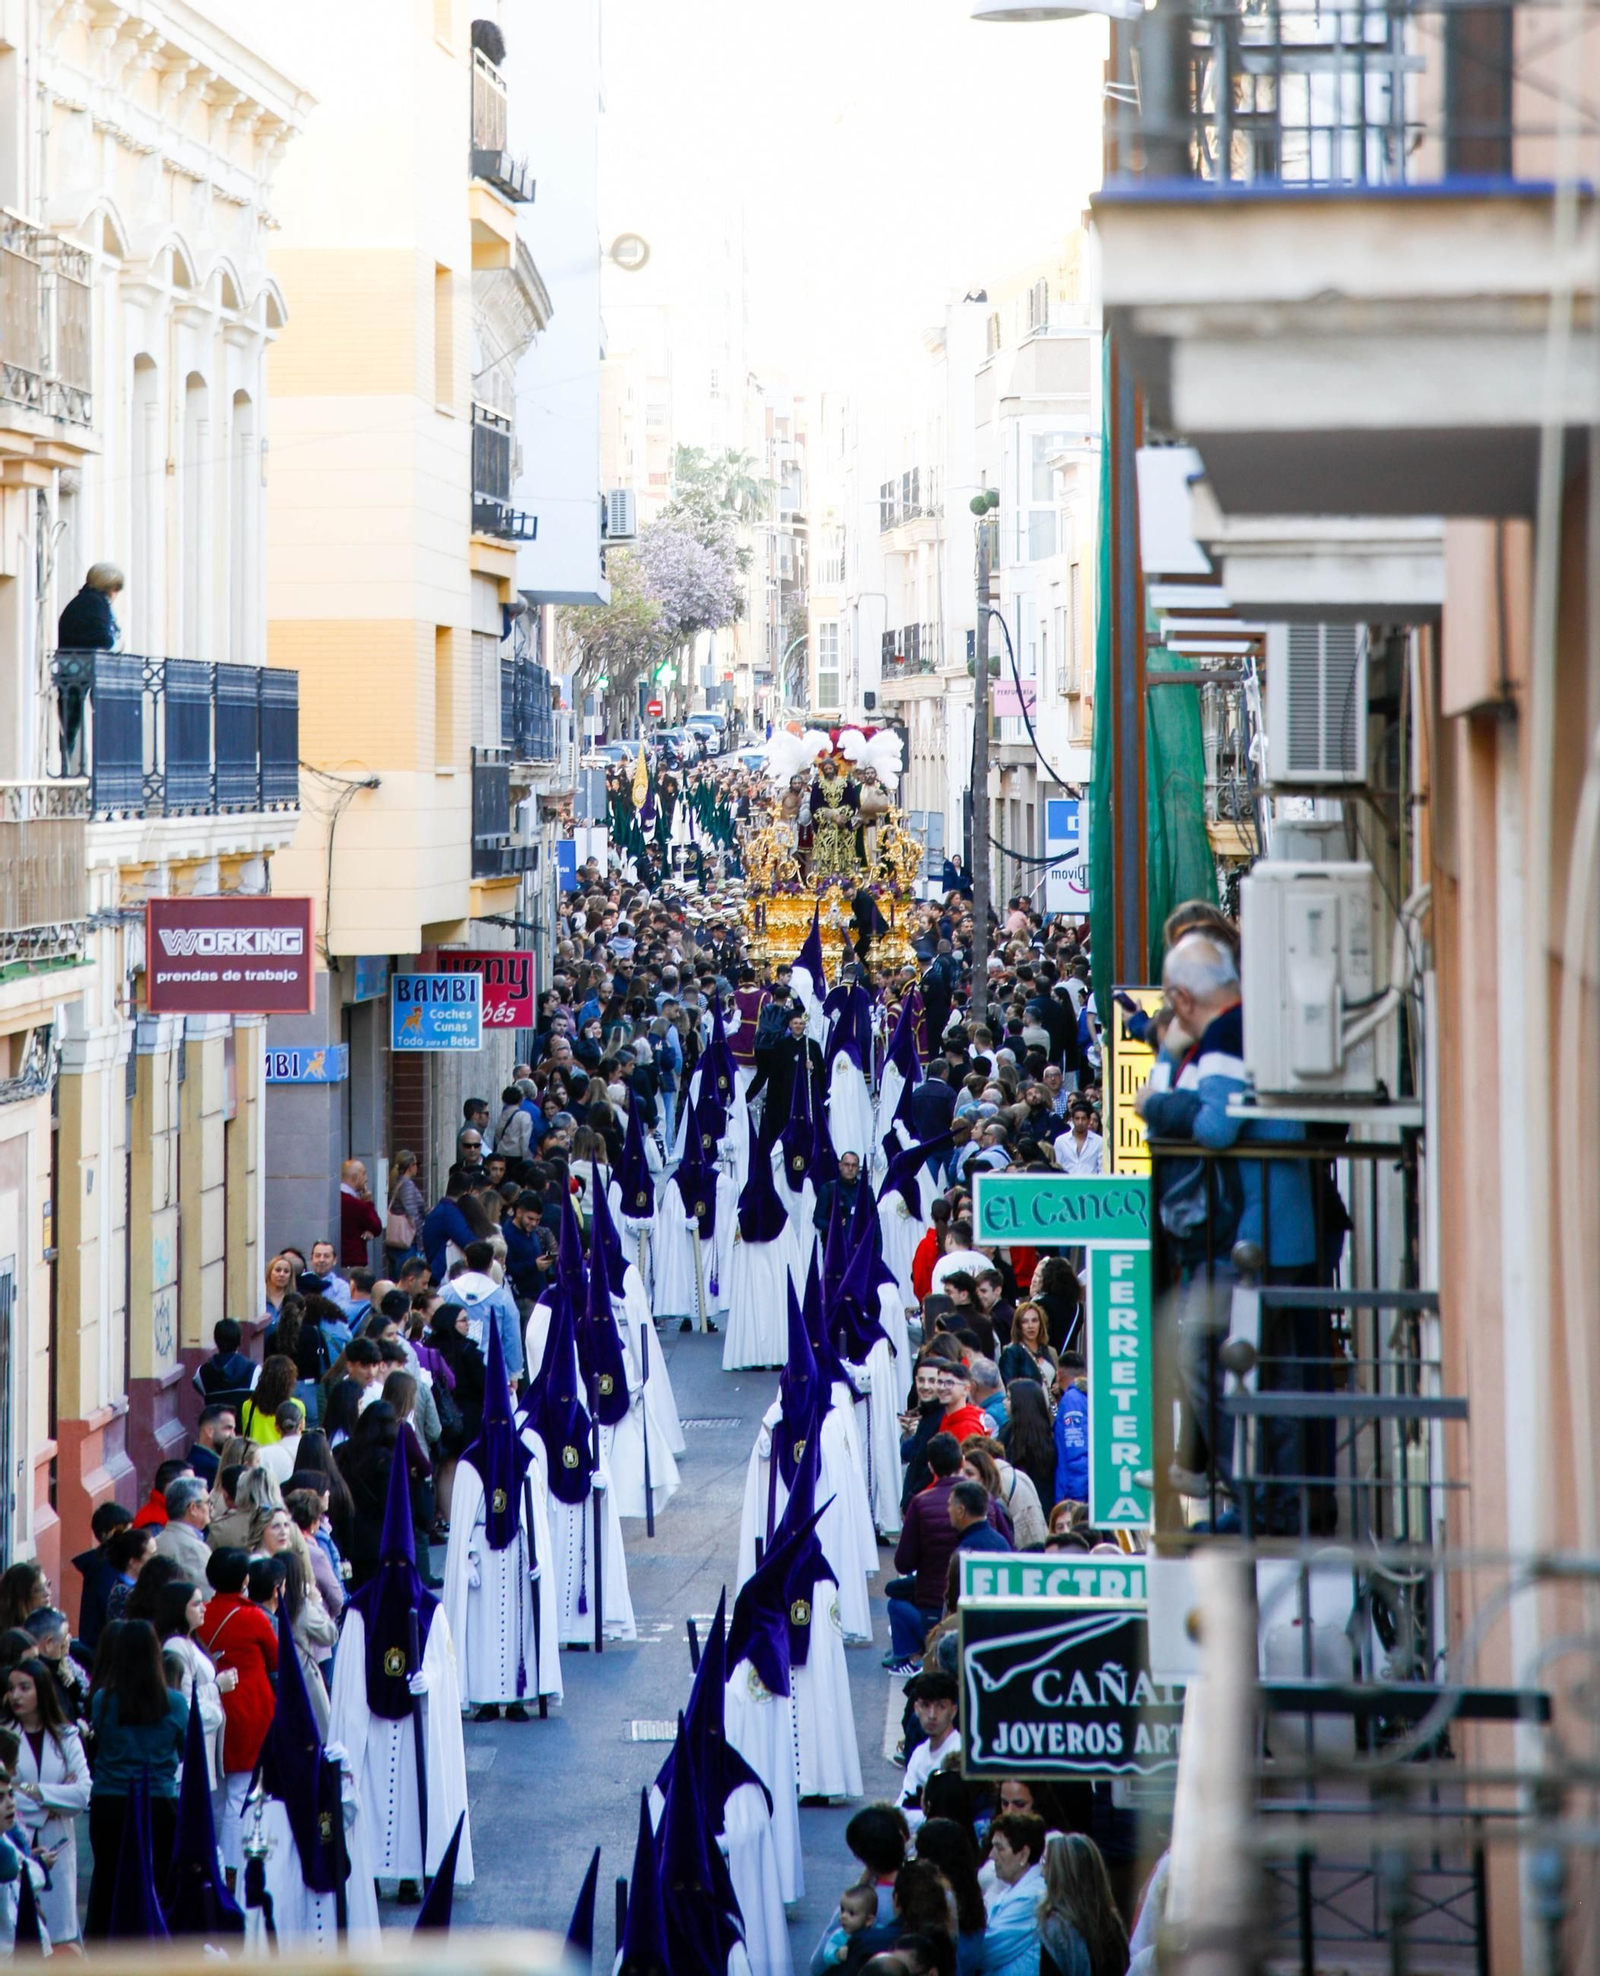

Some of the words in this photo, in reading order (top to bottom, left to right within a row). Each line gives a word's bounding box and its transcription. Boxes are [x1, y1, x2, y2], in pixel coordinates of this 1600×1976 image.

[158, 928, 304, 956] WORKING
[156, 970, 219, 984] prendas
[222, 968, 242, 981] de
[245, 968, 298, 983] trabajo
[396, 978, 477, 1003] BAMBI
[429, 1009, 473, 1020] Coches
[434, 1021, 468, 1032] Cunas
[397, 1035, 424, 1047] Todo
[1108, 1254, 1145, 1520] FERRETERÍA
[992, 1721, 1124, 1755] JOYEROS
